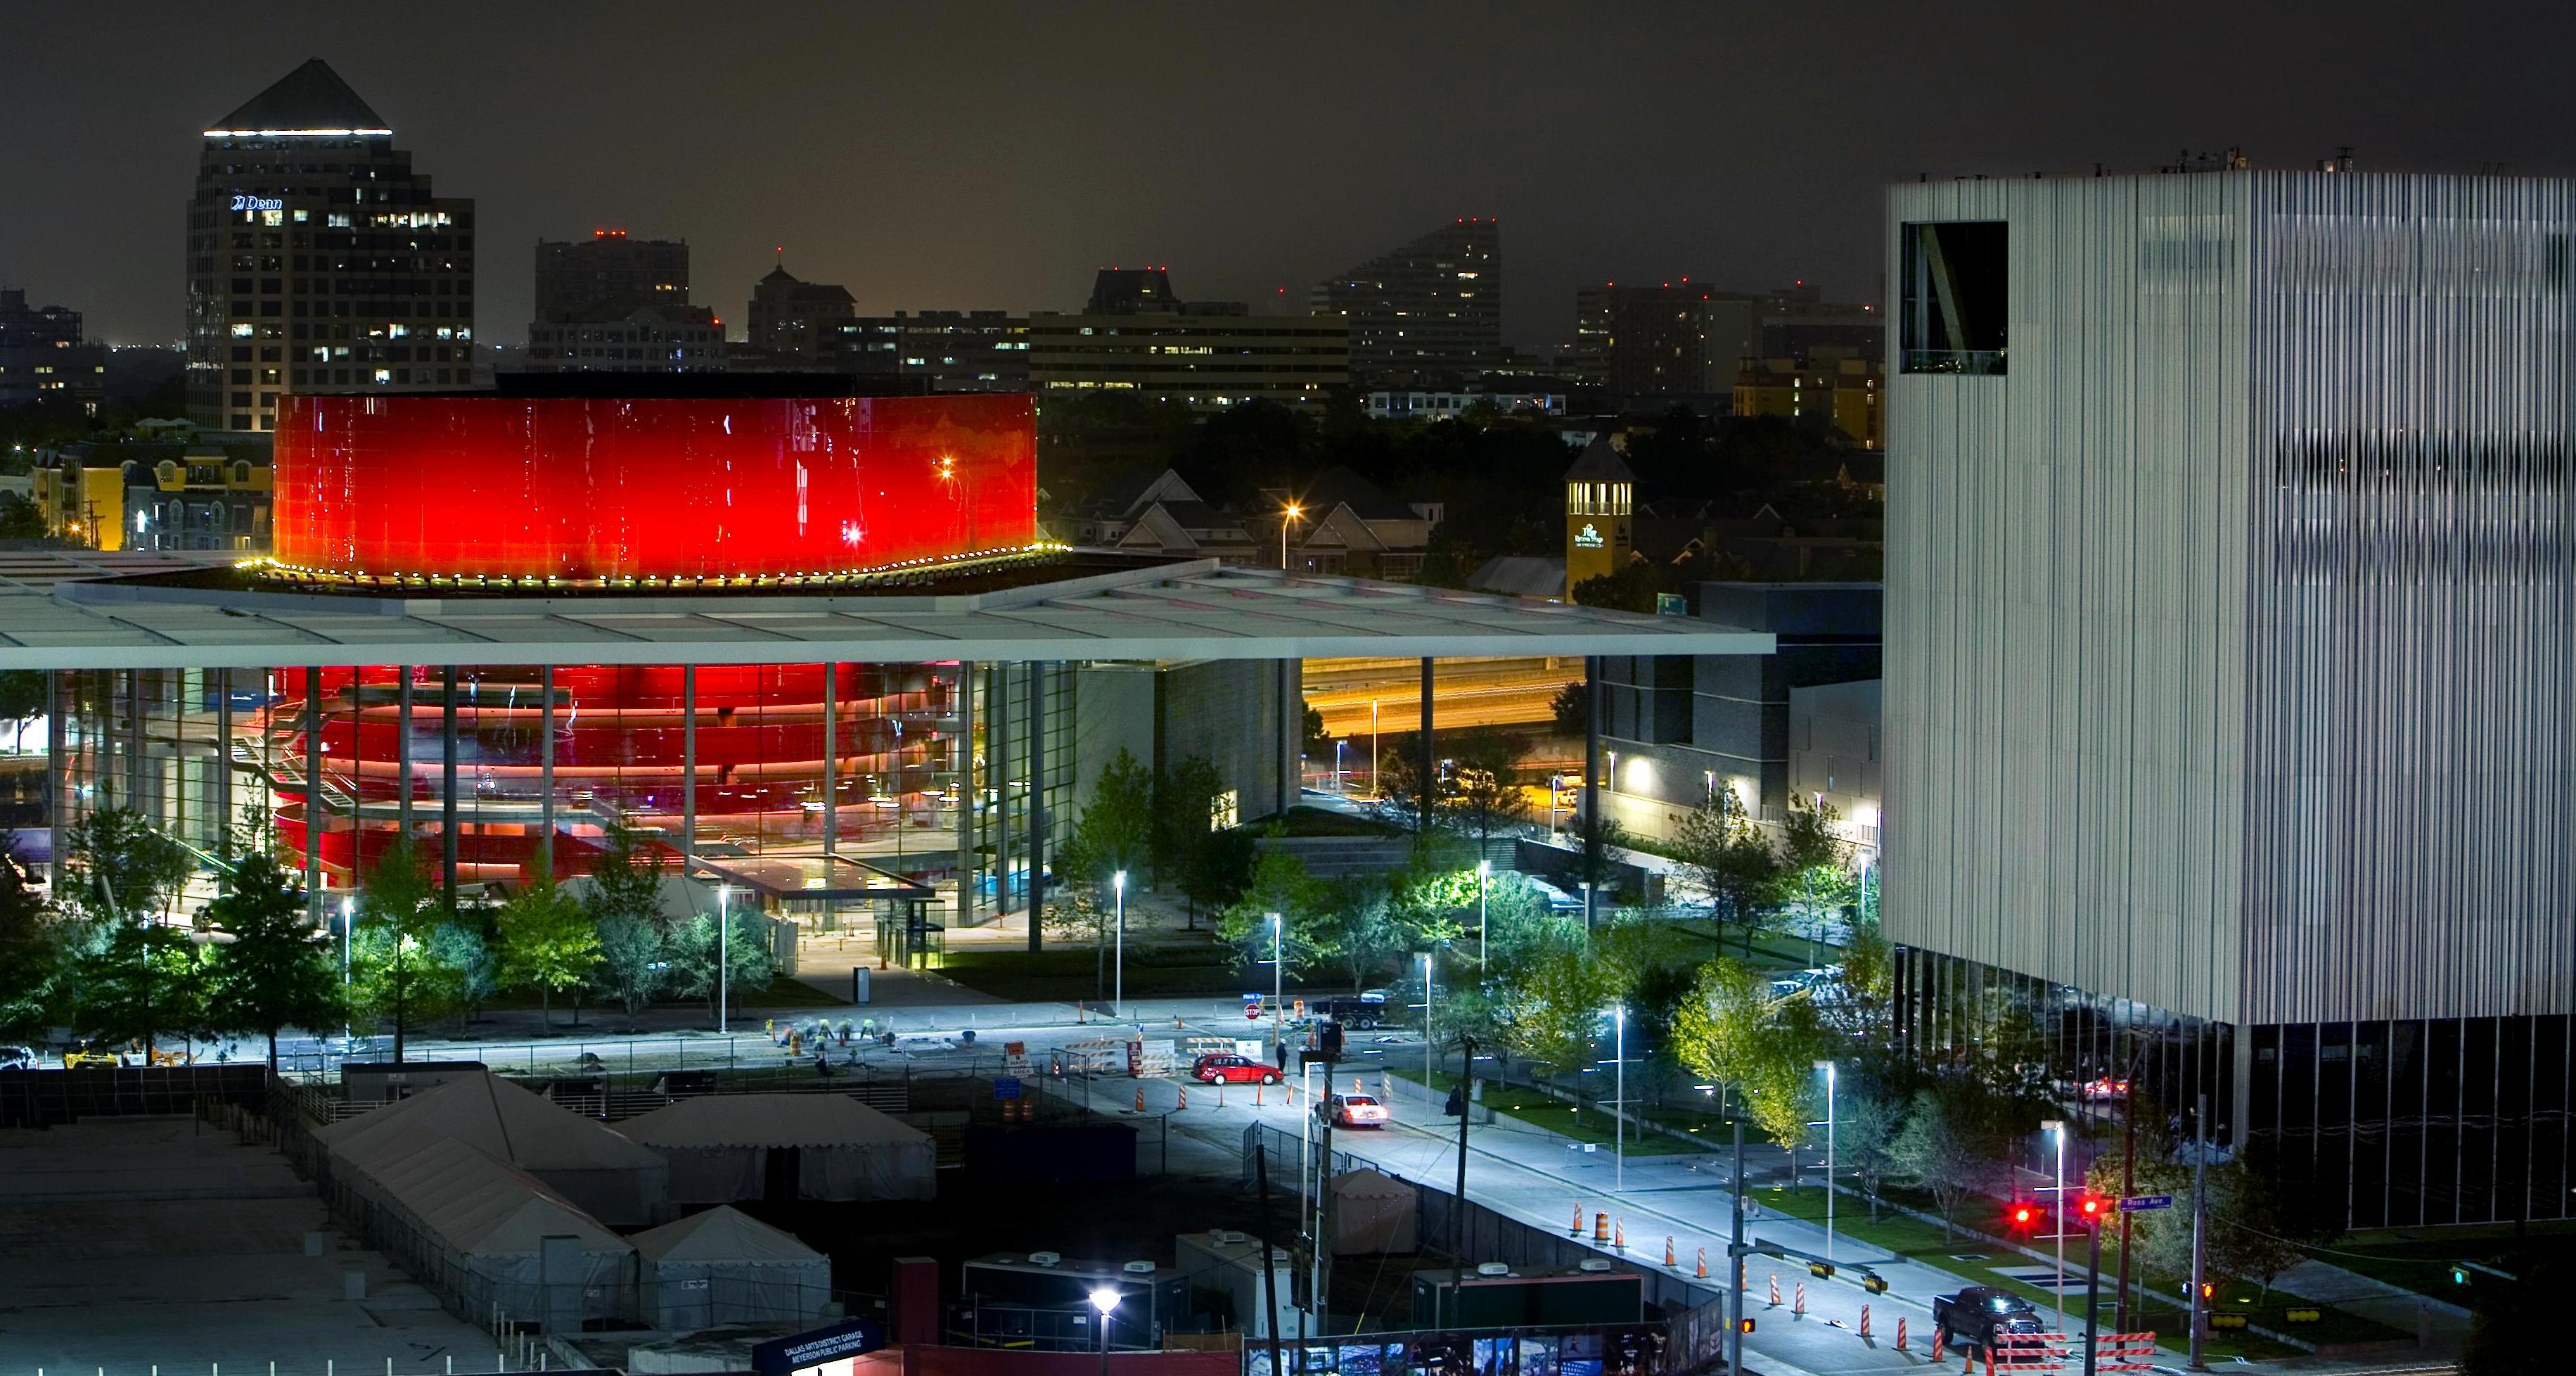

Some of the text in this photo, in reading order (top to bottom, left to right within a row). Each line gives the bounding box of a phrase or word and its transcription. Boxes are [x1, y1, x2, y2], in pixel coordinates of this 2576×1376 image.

[245, 196, 283, 210] Dean
[784, 1330, 864, 1356] DALLAS ARTS DISTRICT GARAGE
[792, 1339, 861, 1364] MEYERSON PUBLIC PARKING
